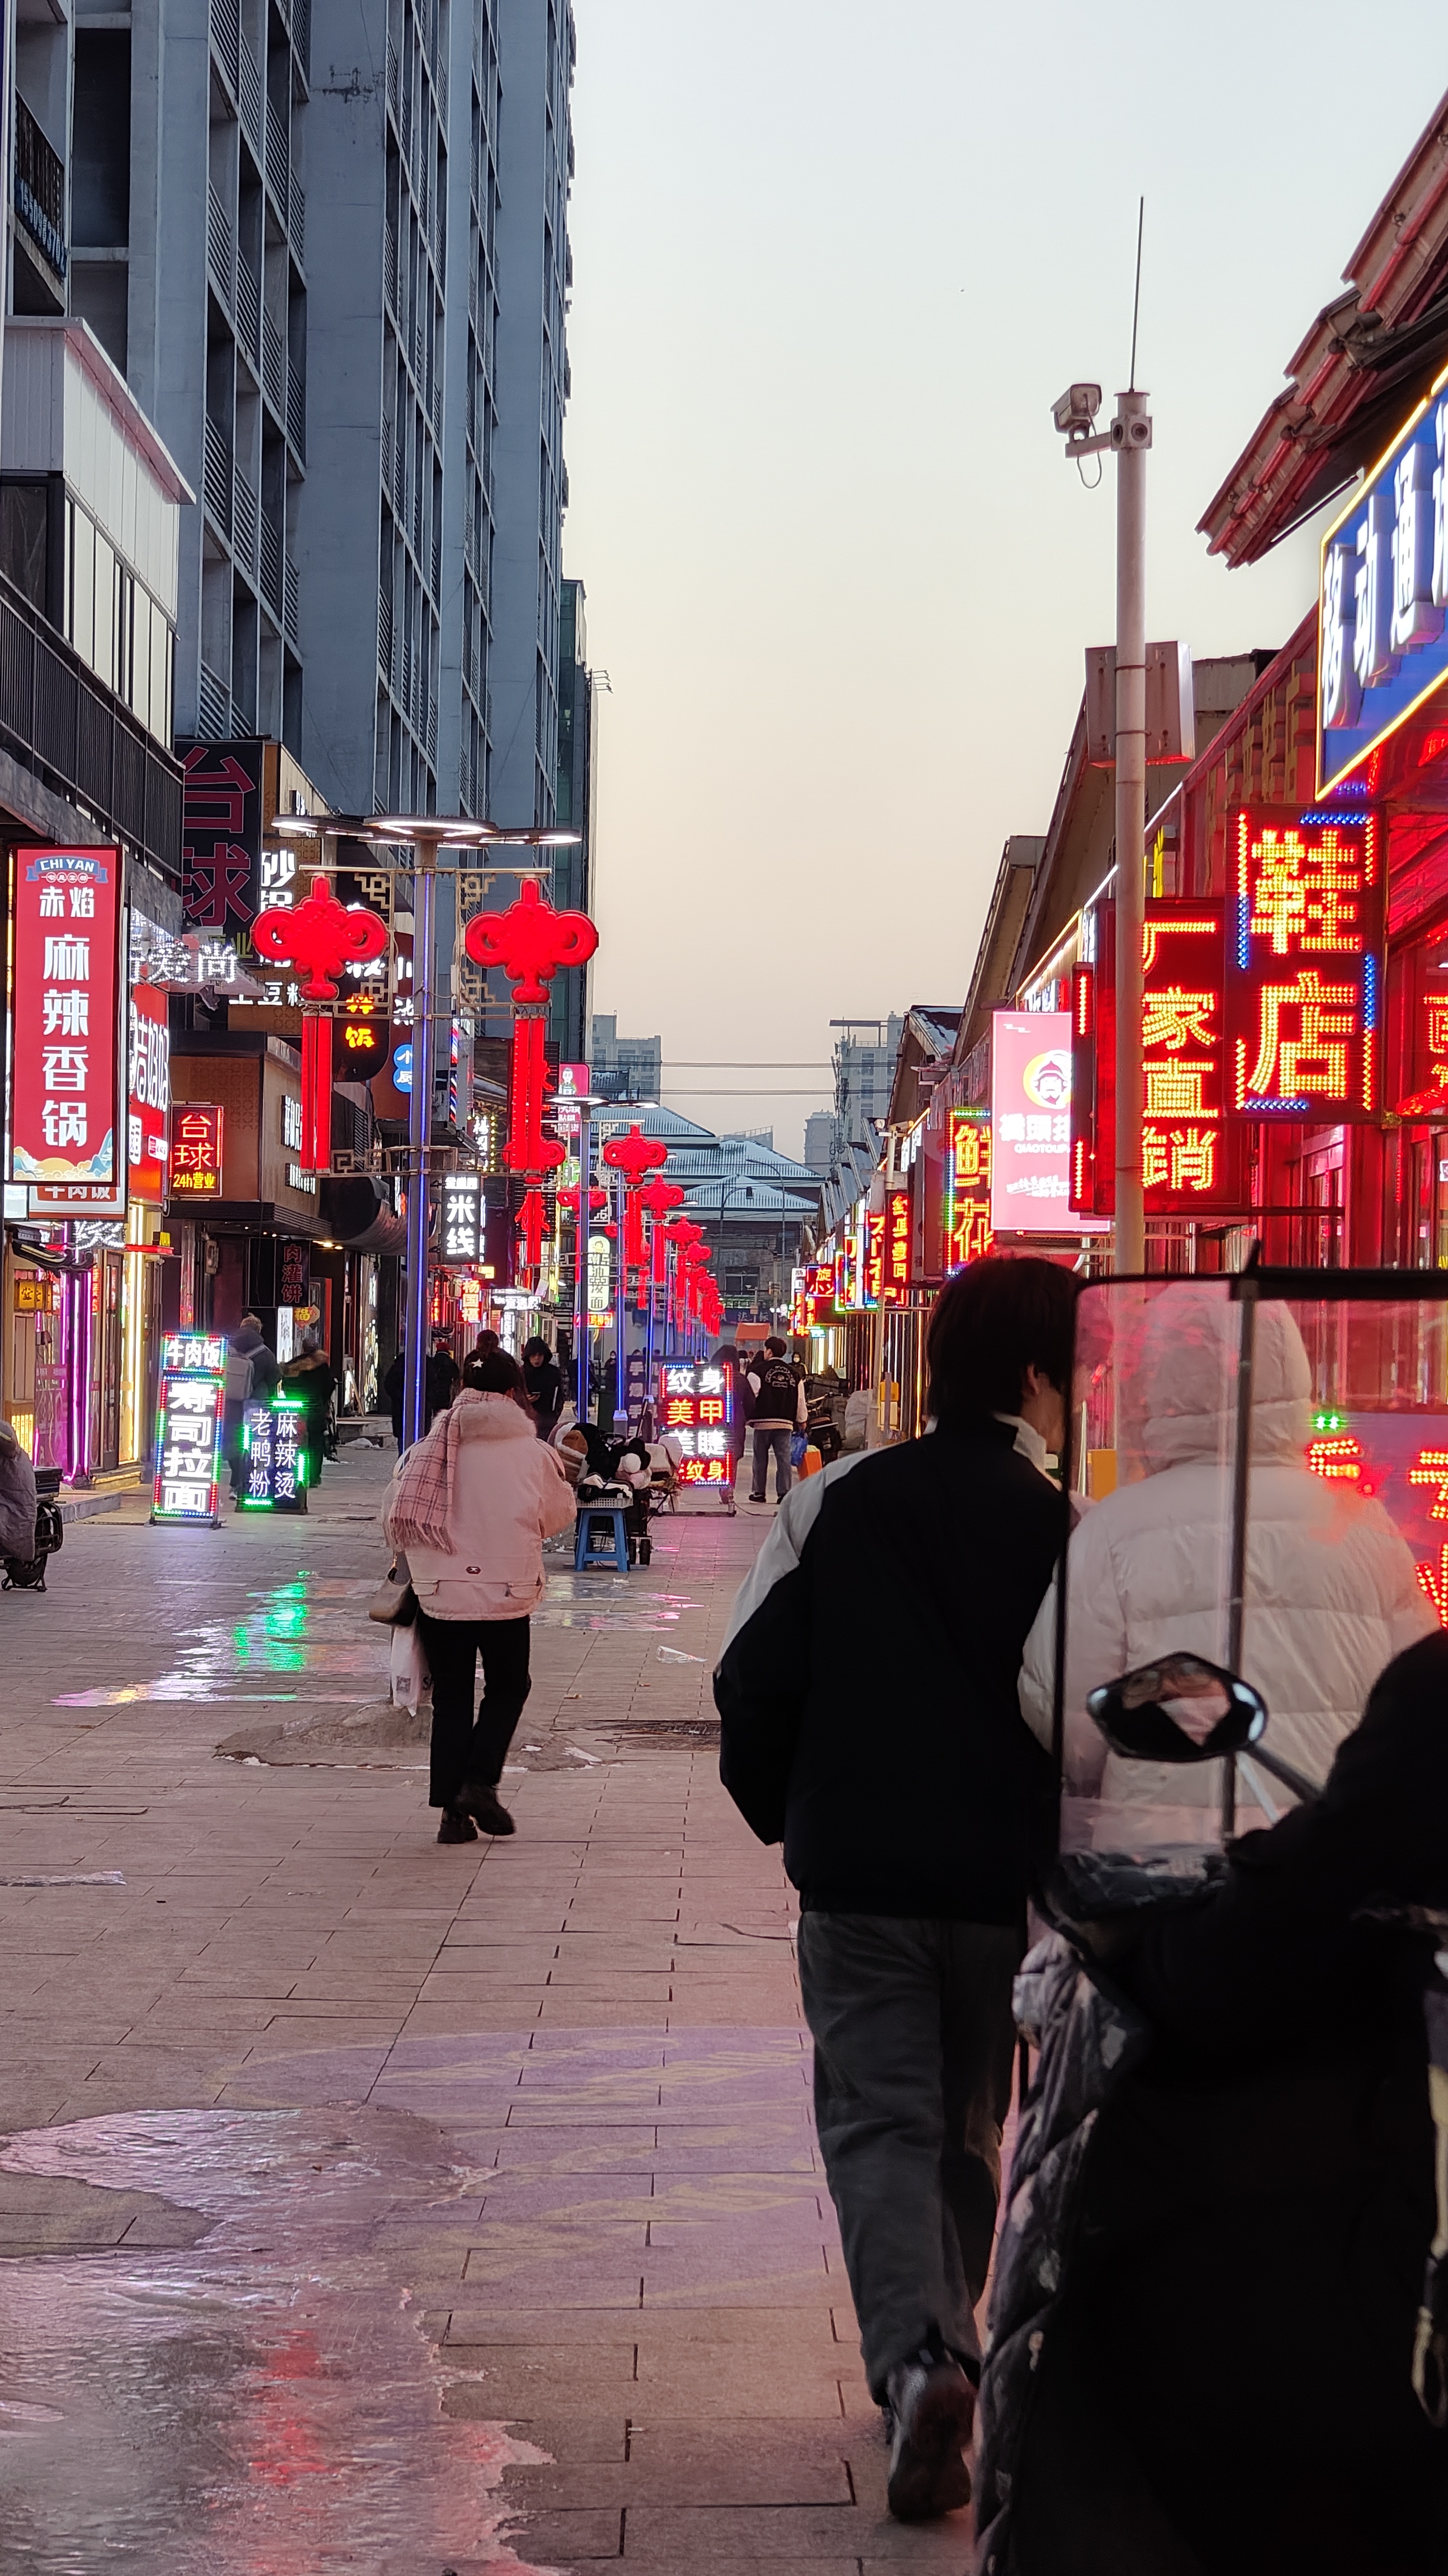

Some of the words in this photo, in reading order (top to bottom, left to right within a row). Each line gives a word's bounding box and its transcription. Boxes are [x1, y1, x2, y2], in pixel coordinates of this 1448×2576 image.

[40, 859, 63, 870] CHI
[66, 859, 94, 872] YAN
[39, 886, 94, 917] 赤焰
[1248, 830, 1361, 1098] 鞋店
[42, 934, 89, 1148] 麻辣香锅
[1143, 921, 1220, 1191] 厂家直销
[174, 1115, 215, 1170] 台球
[173, 1172, 215, 1188] 24h营业
[447, 1195, 475, 1257] 米线
[281, 1244, 304, 1304] 肉灌饼
[462, 1280, 480, 1322] 杨国福
[294, 1308, 311, 1322] 福
[168, 1339, 221, 1367] 牛肉饭
[666, 1367, 725, 1394] 纹身
[667, 1399, 723, 1425] 美甲
[161, 1381, 217, 1512] 寿司拉面
[249, 1408, 273, 1498] 老鸭粉
[275, 1409, 298, 1499] 麻辣烫
